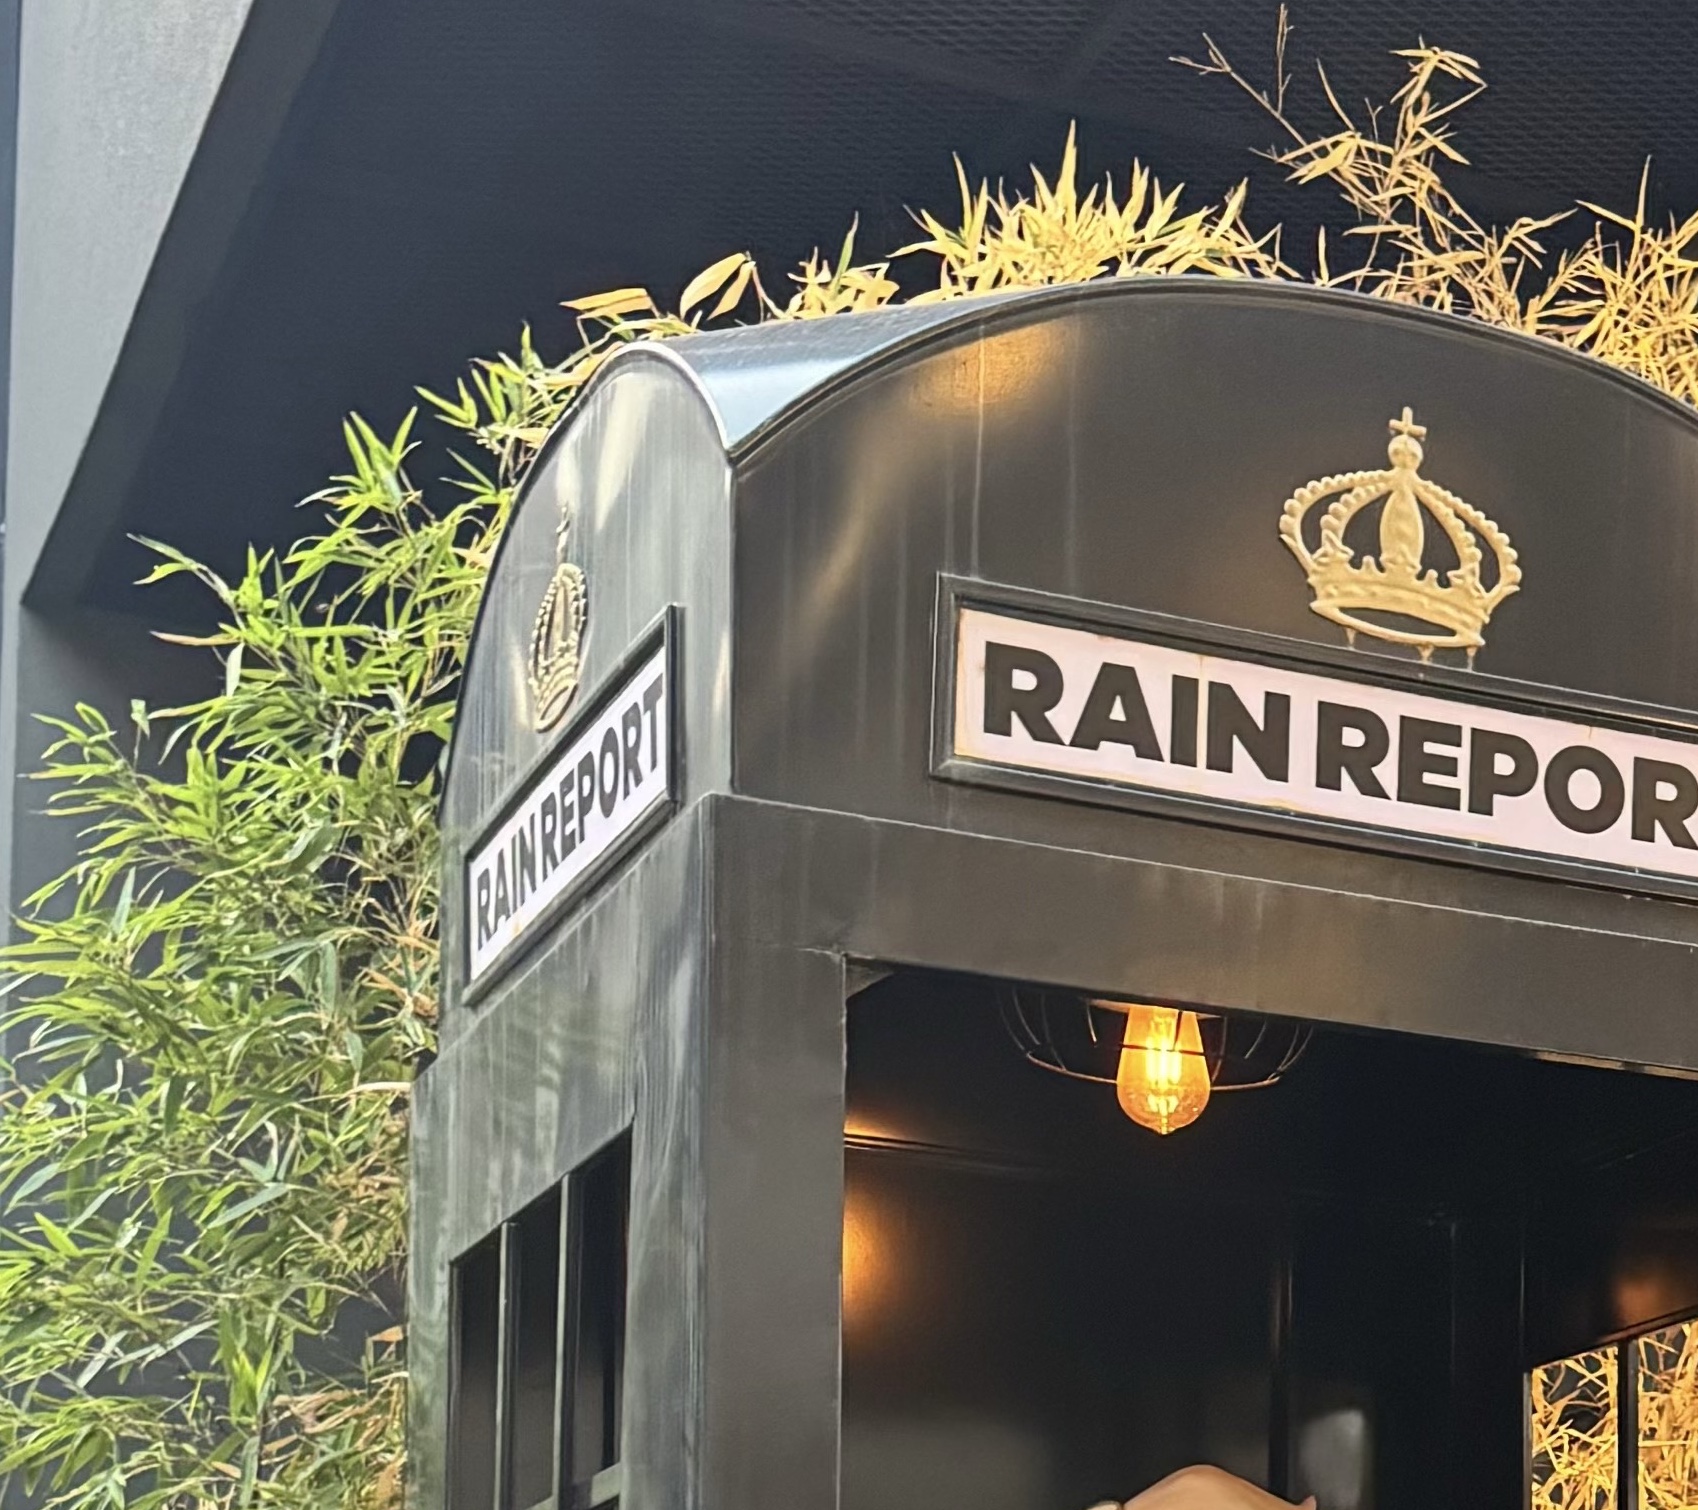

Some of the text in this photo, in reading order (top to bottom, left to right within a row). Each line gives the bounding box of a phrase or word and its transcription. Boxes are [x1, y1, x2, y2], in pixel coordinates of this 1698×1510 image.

[476, 672, 664, 951] RAIN REPORT
[983, 641, 1290, 783] RAIN
